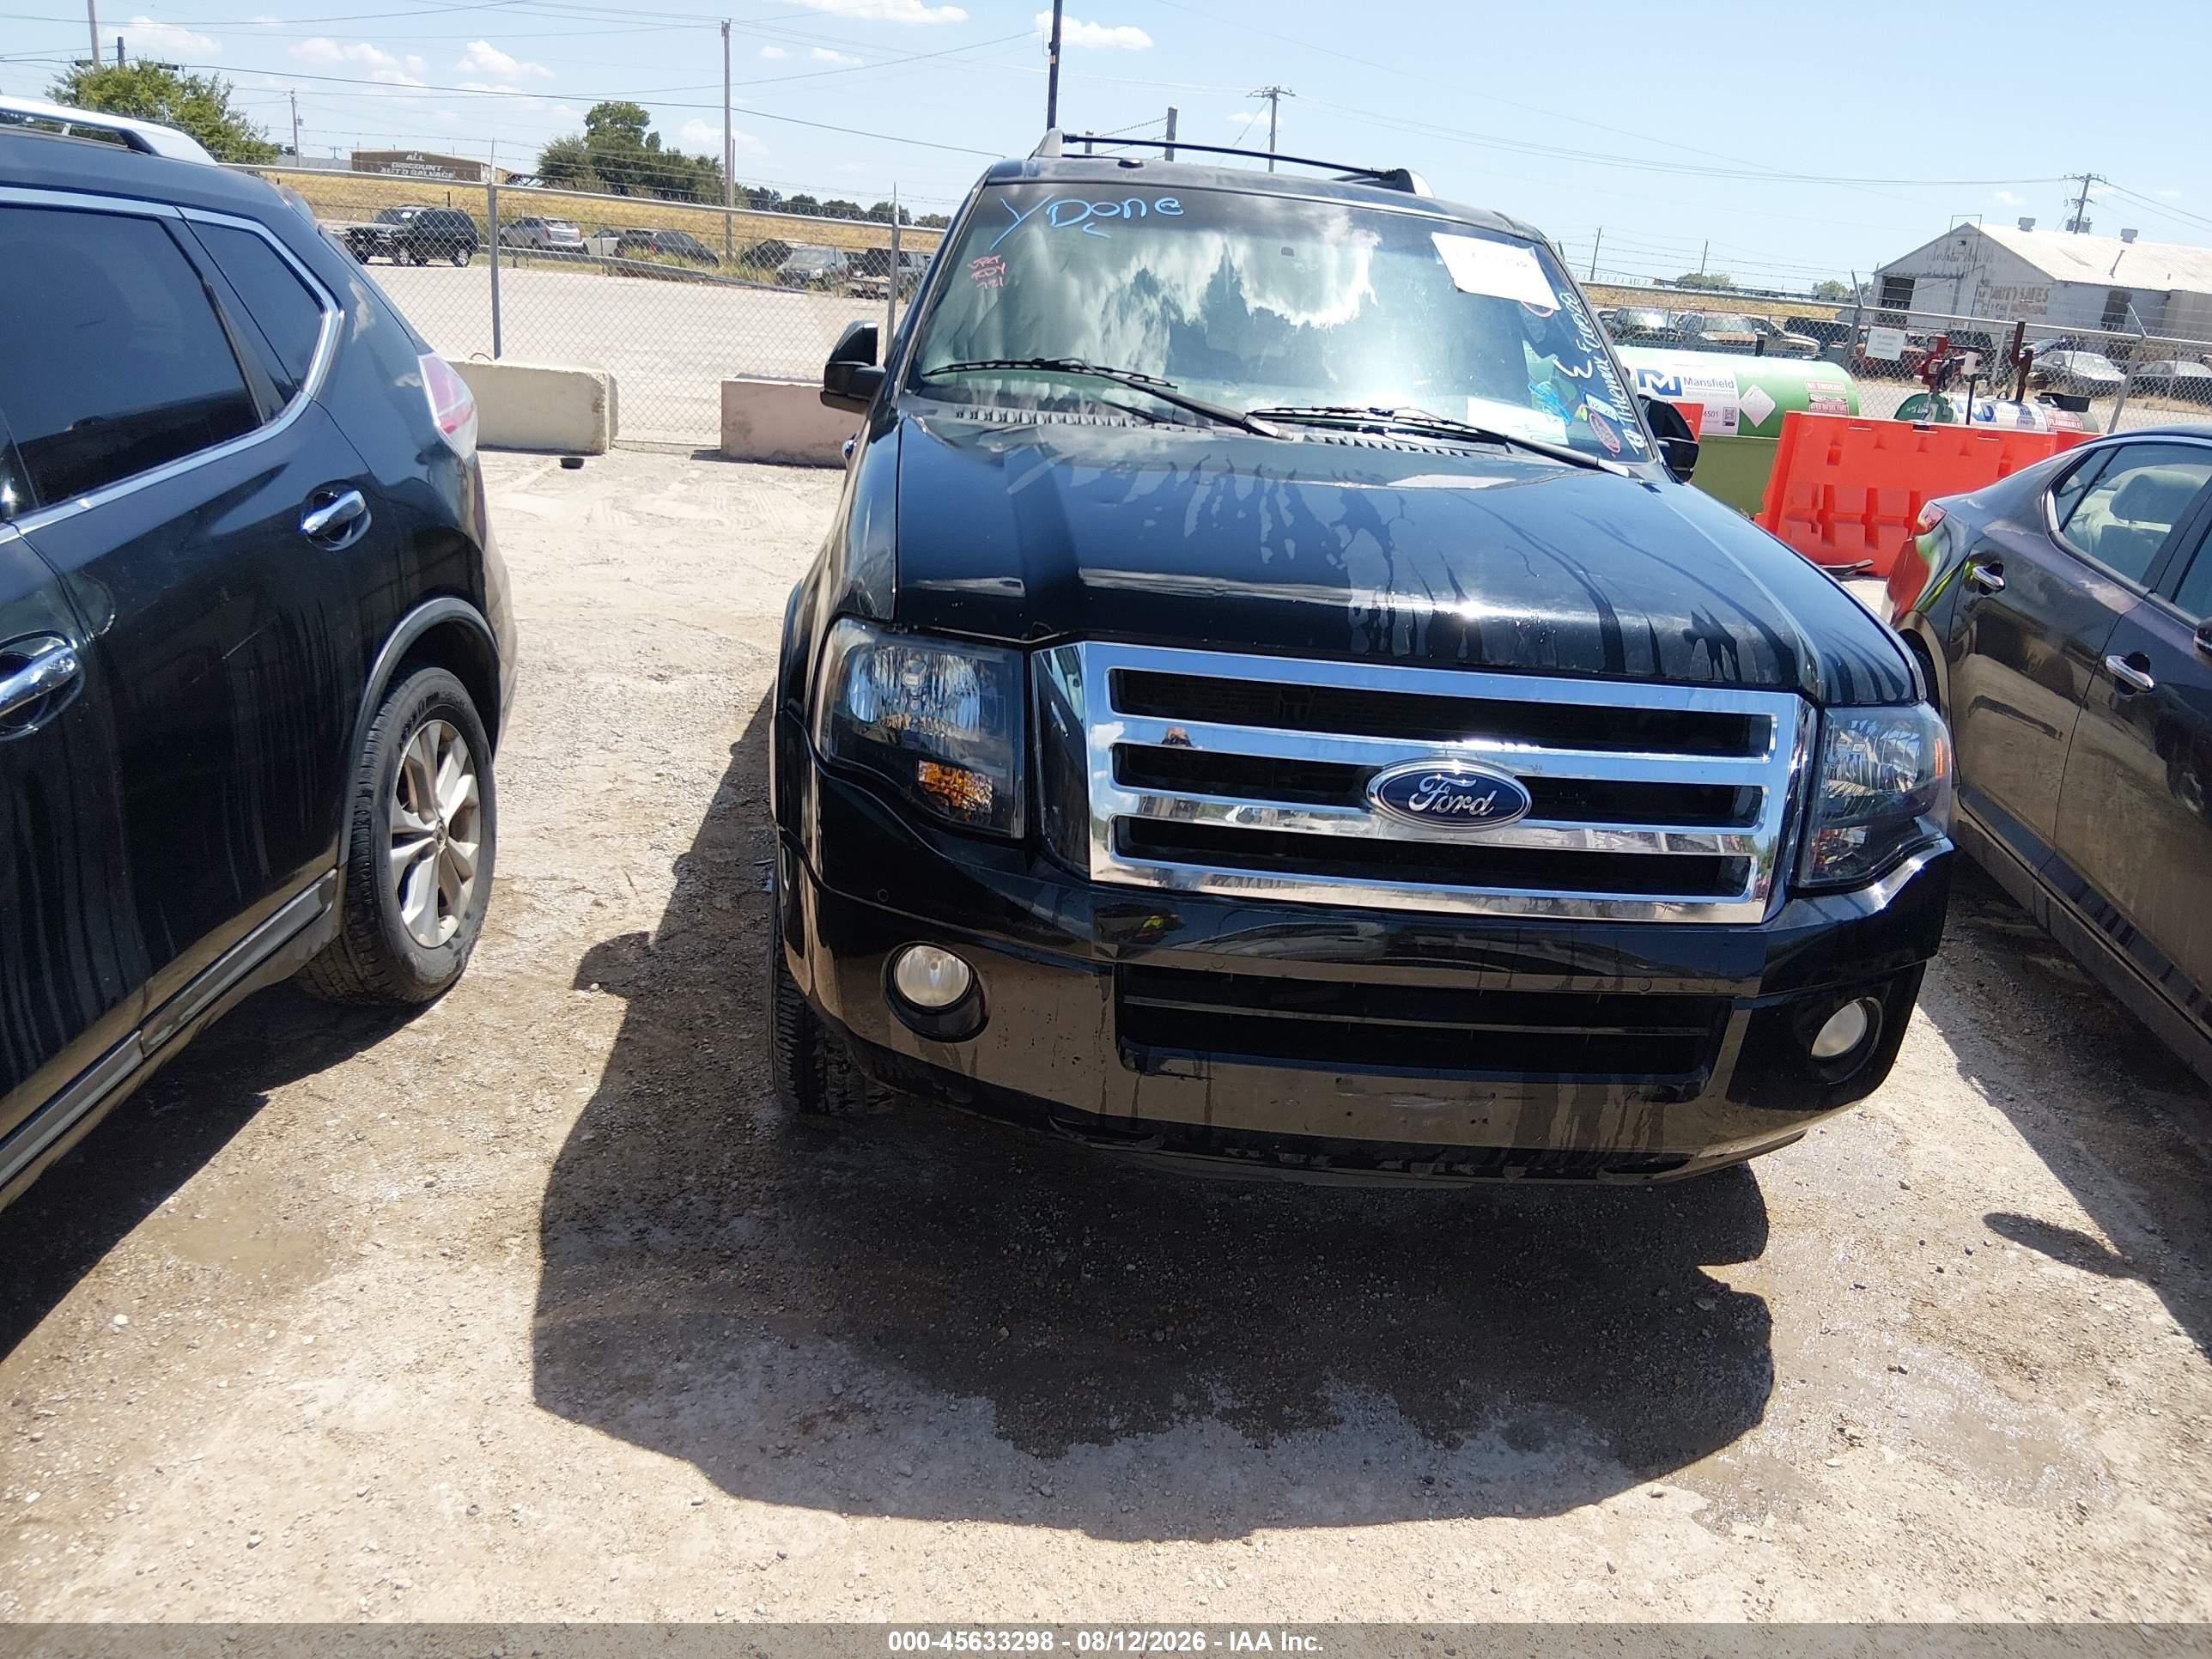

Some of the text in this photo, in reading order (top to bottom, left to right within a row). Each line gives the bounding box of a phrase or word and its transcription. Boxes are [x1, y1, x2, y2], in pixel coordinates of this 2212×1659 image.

[391, 161, 443, 172] DISCOUNT
[380, 167, 455, 179] AUTO SALVAGE
[1683, 377, 1735, 389] Mansfield
[1408, 775, 1498, 817] Ford
